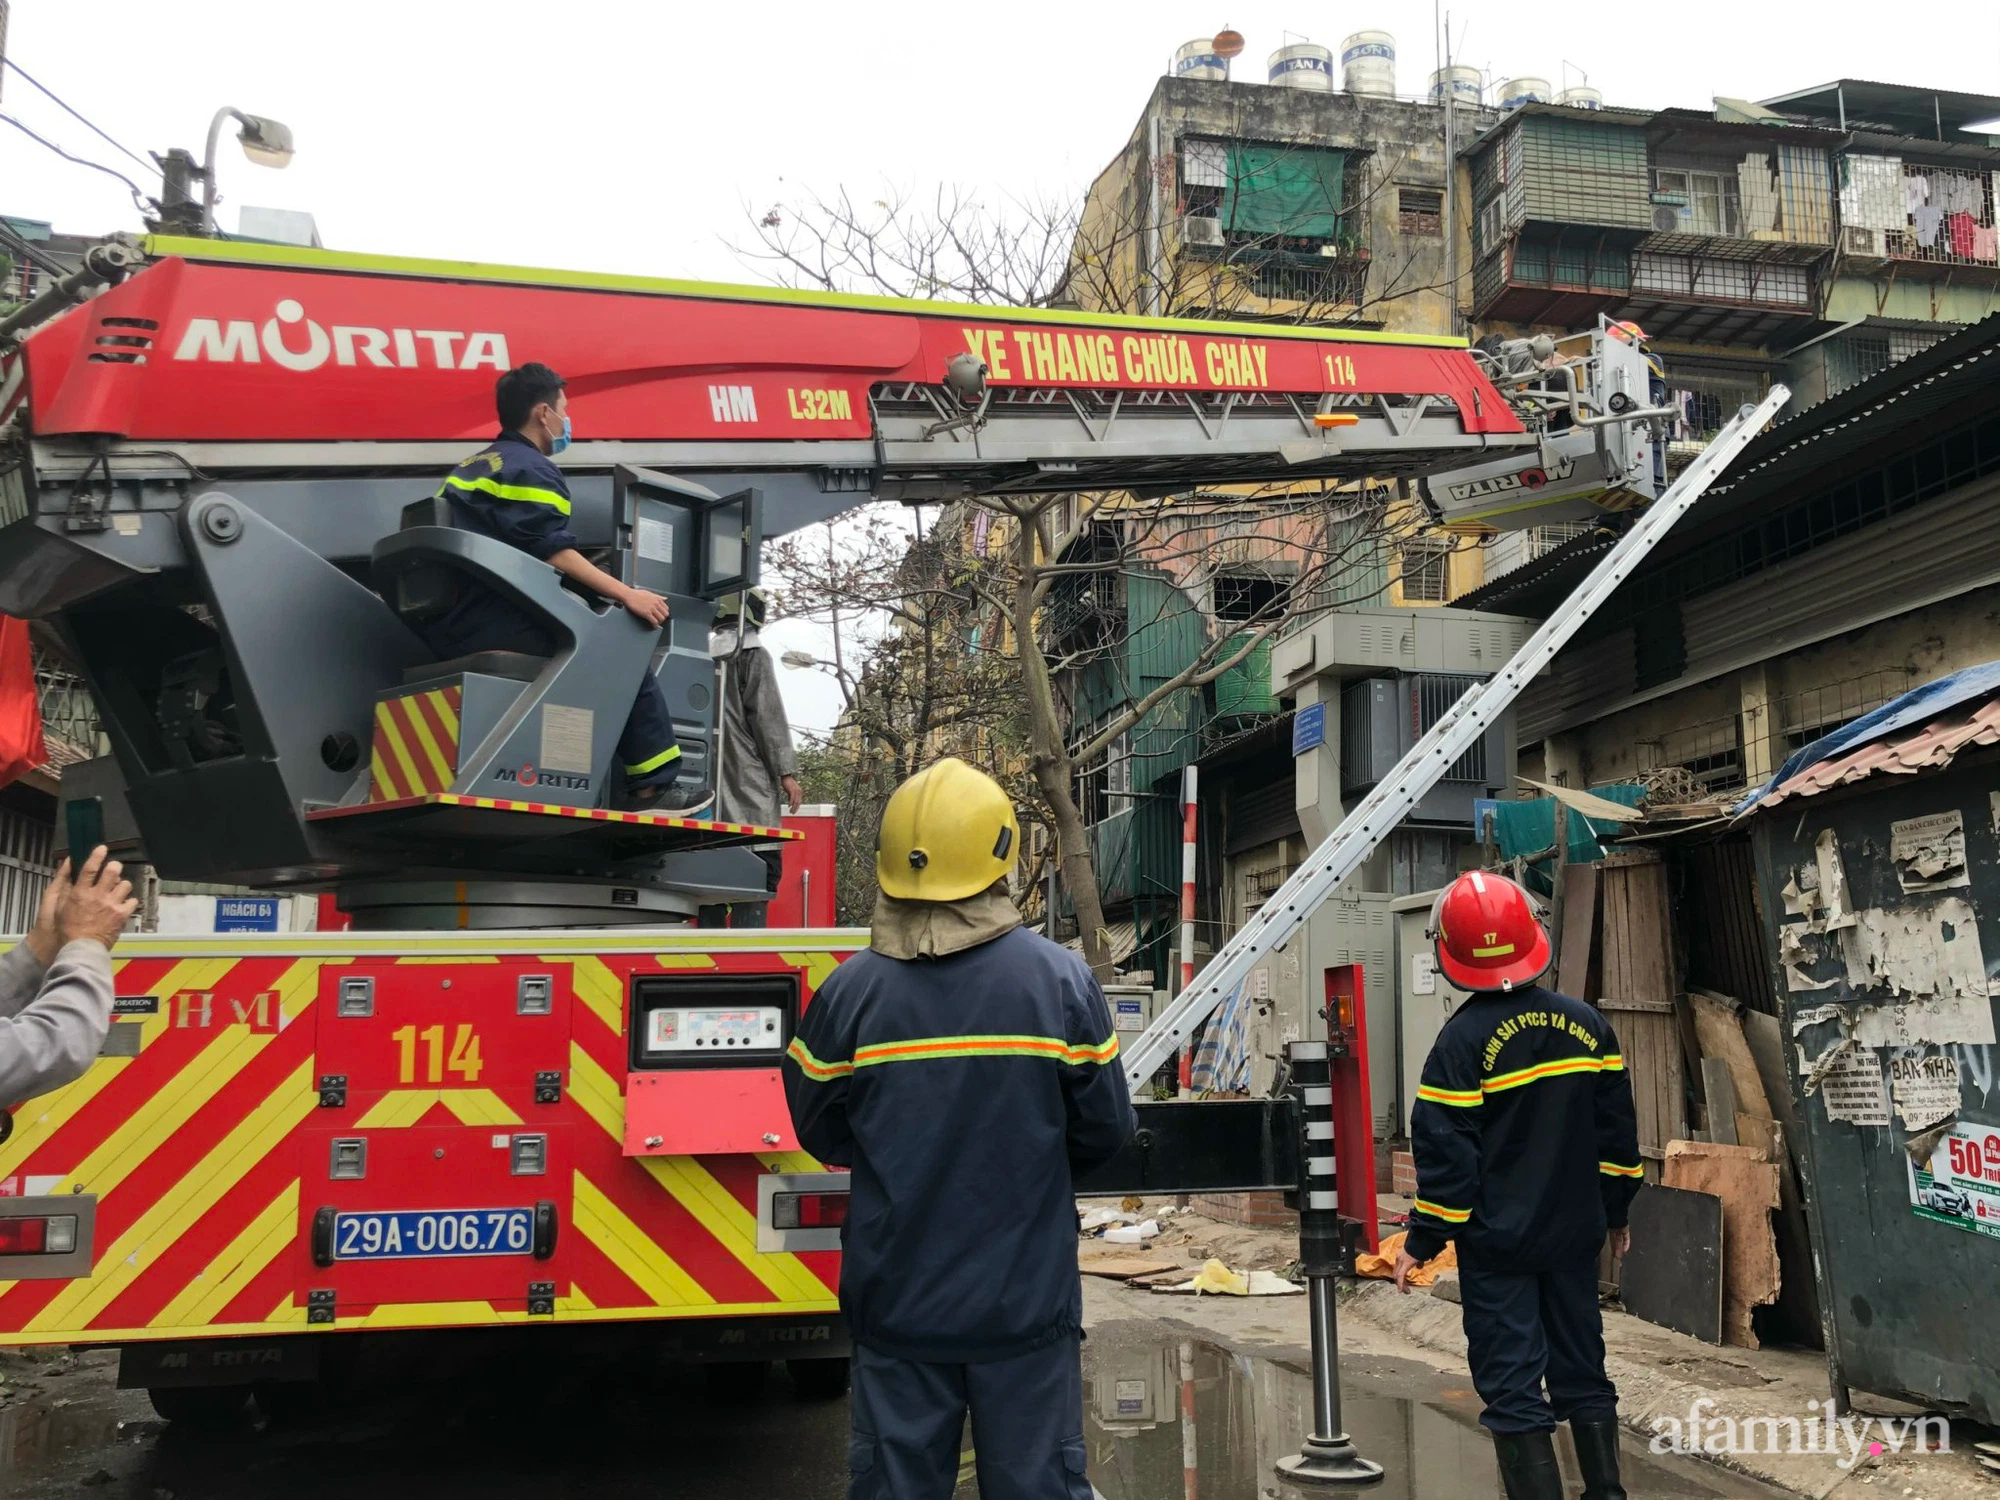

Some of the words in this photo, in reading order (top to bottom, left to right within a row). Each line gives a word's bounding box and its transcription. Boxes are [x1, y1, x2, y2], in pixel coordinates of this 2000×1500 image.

[173, 299, 512, 372] MORITA
[963, 328, 1012, 380] XE
[1013, 330, 1120, 382] THANG
[1122, 333, 1199, 385] CHỮA
[1204, 337, 1269, 388] CHÁY
[1325, 354, 1357, 387] 114
[708, 384, 759, 423] HM
[787, 388, 853, 421] L32M
[494, 763, 591, 792] MORITA
[222, 900, 257, 917] NGÁCH
[258, 903, 272, 917] 64
[1483, 932, 1497, 946] 17
[391, 1023, 484, 1084] 114
[1568, 1021, 1599, 1052] CNCH
[1949, 1137, 1983, 1179] 50
[339, 1212, 528, 1256] 29A-006.76
